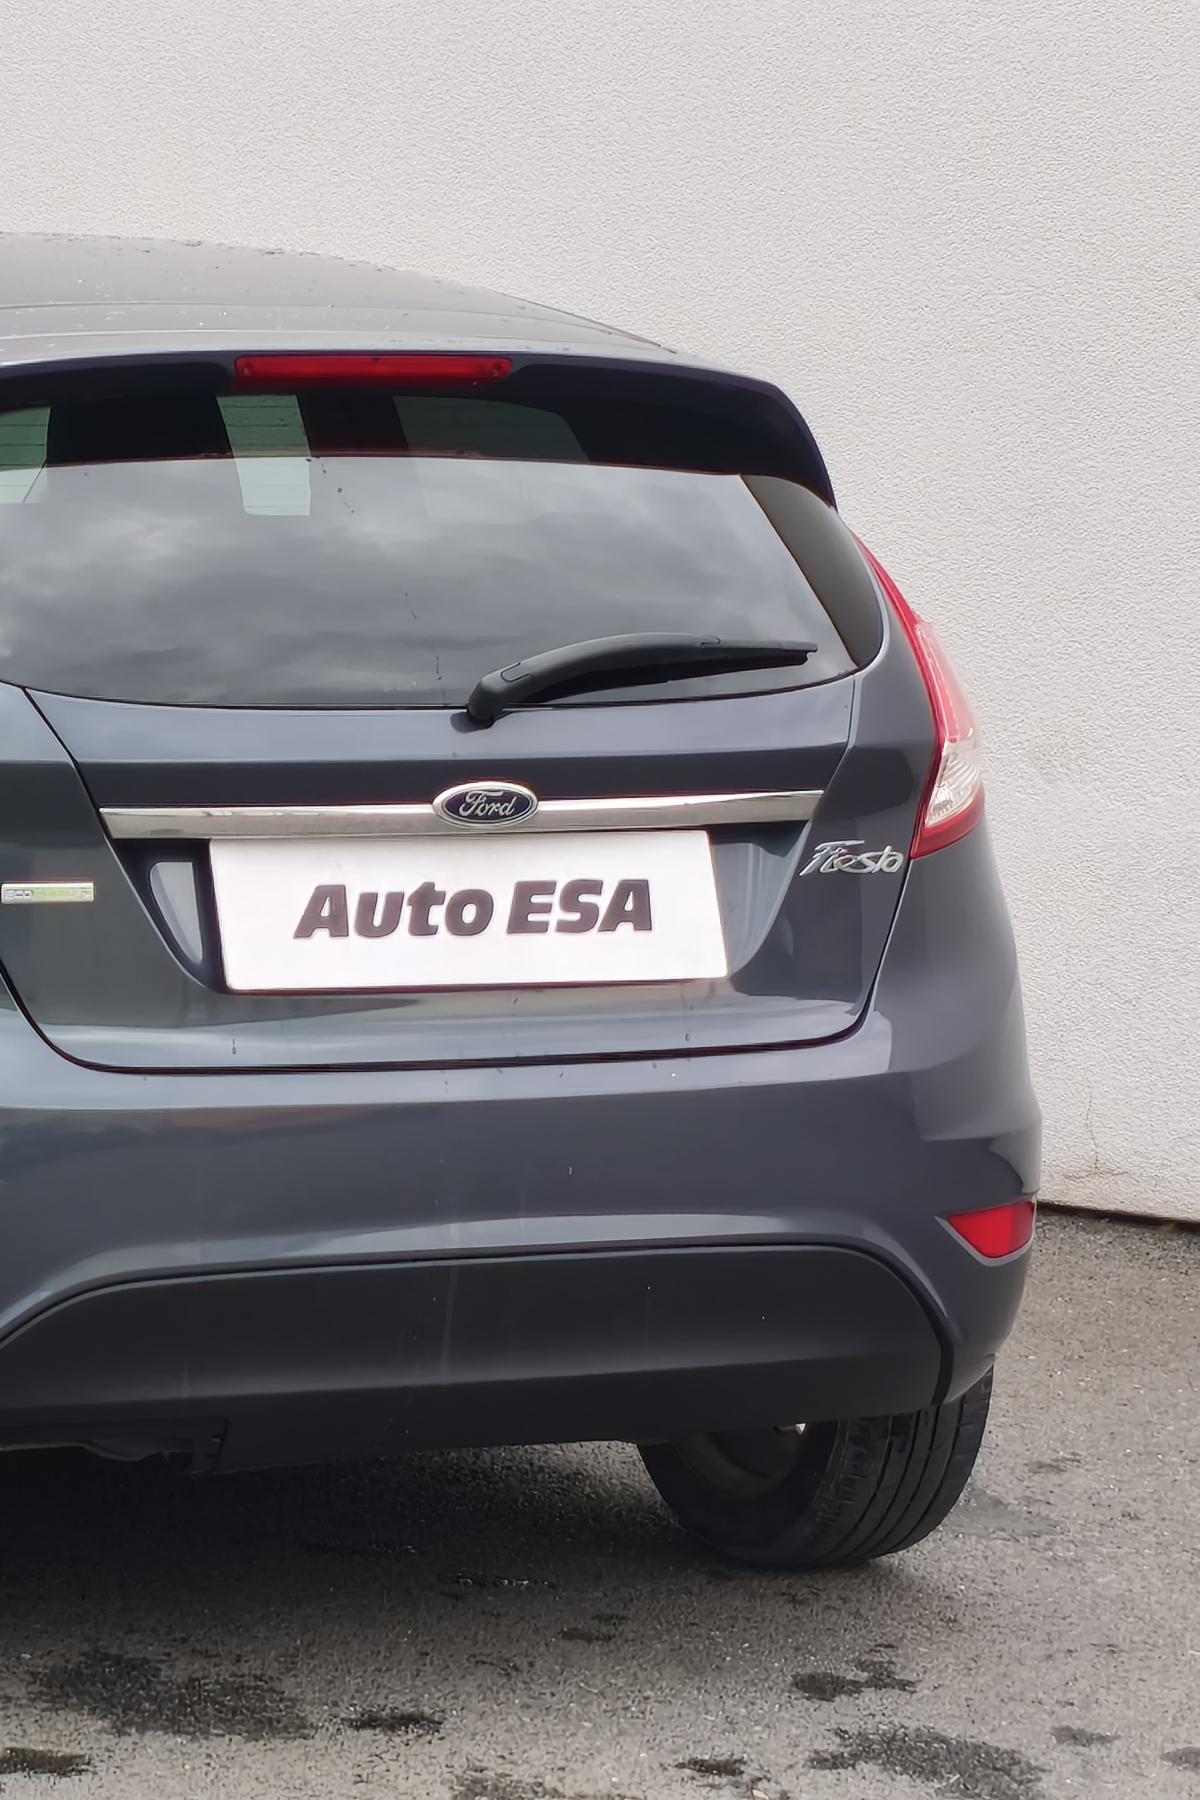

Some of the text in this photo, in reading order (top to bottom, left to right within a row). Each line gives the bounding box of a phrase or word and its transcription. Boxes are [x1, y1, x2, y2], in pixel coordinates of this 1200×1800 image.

[459, 790, 517, 817] Ford
[799, 840, 904, 876] Fiesta
[293, 878, 652, 938] Auto ESA
